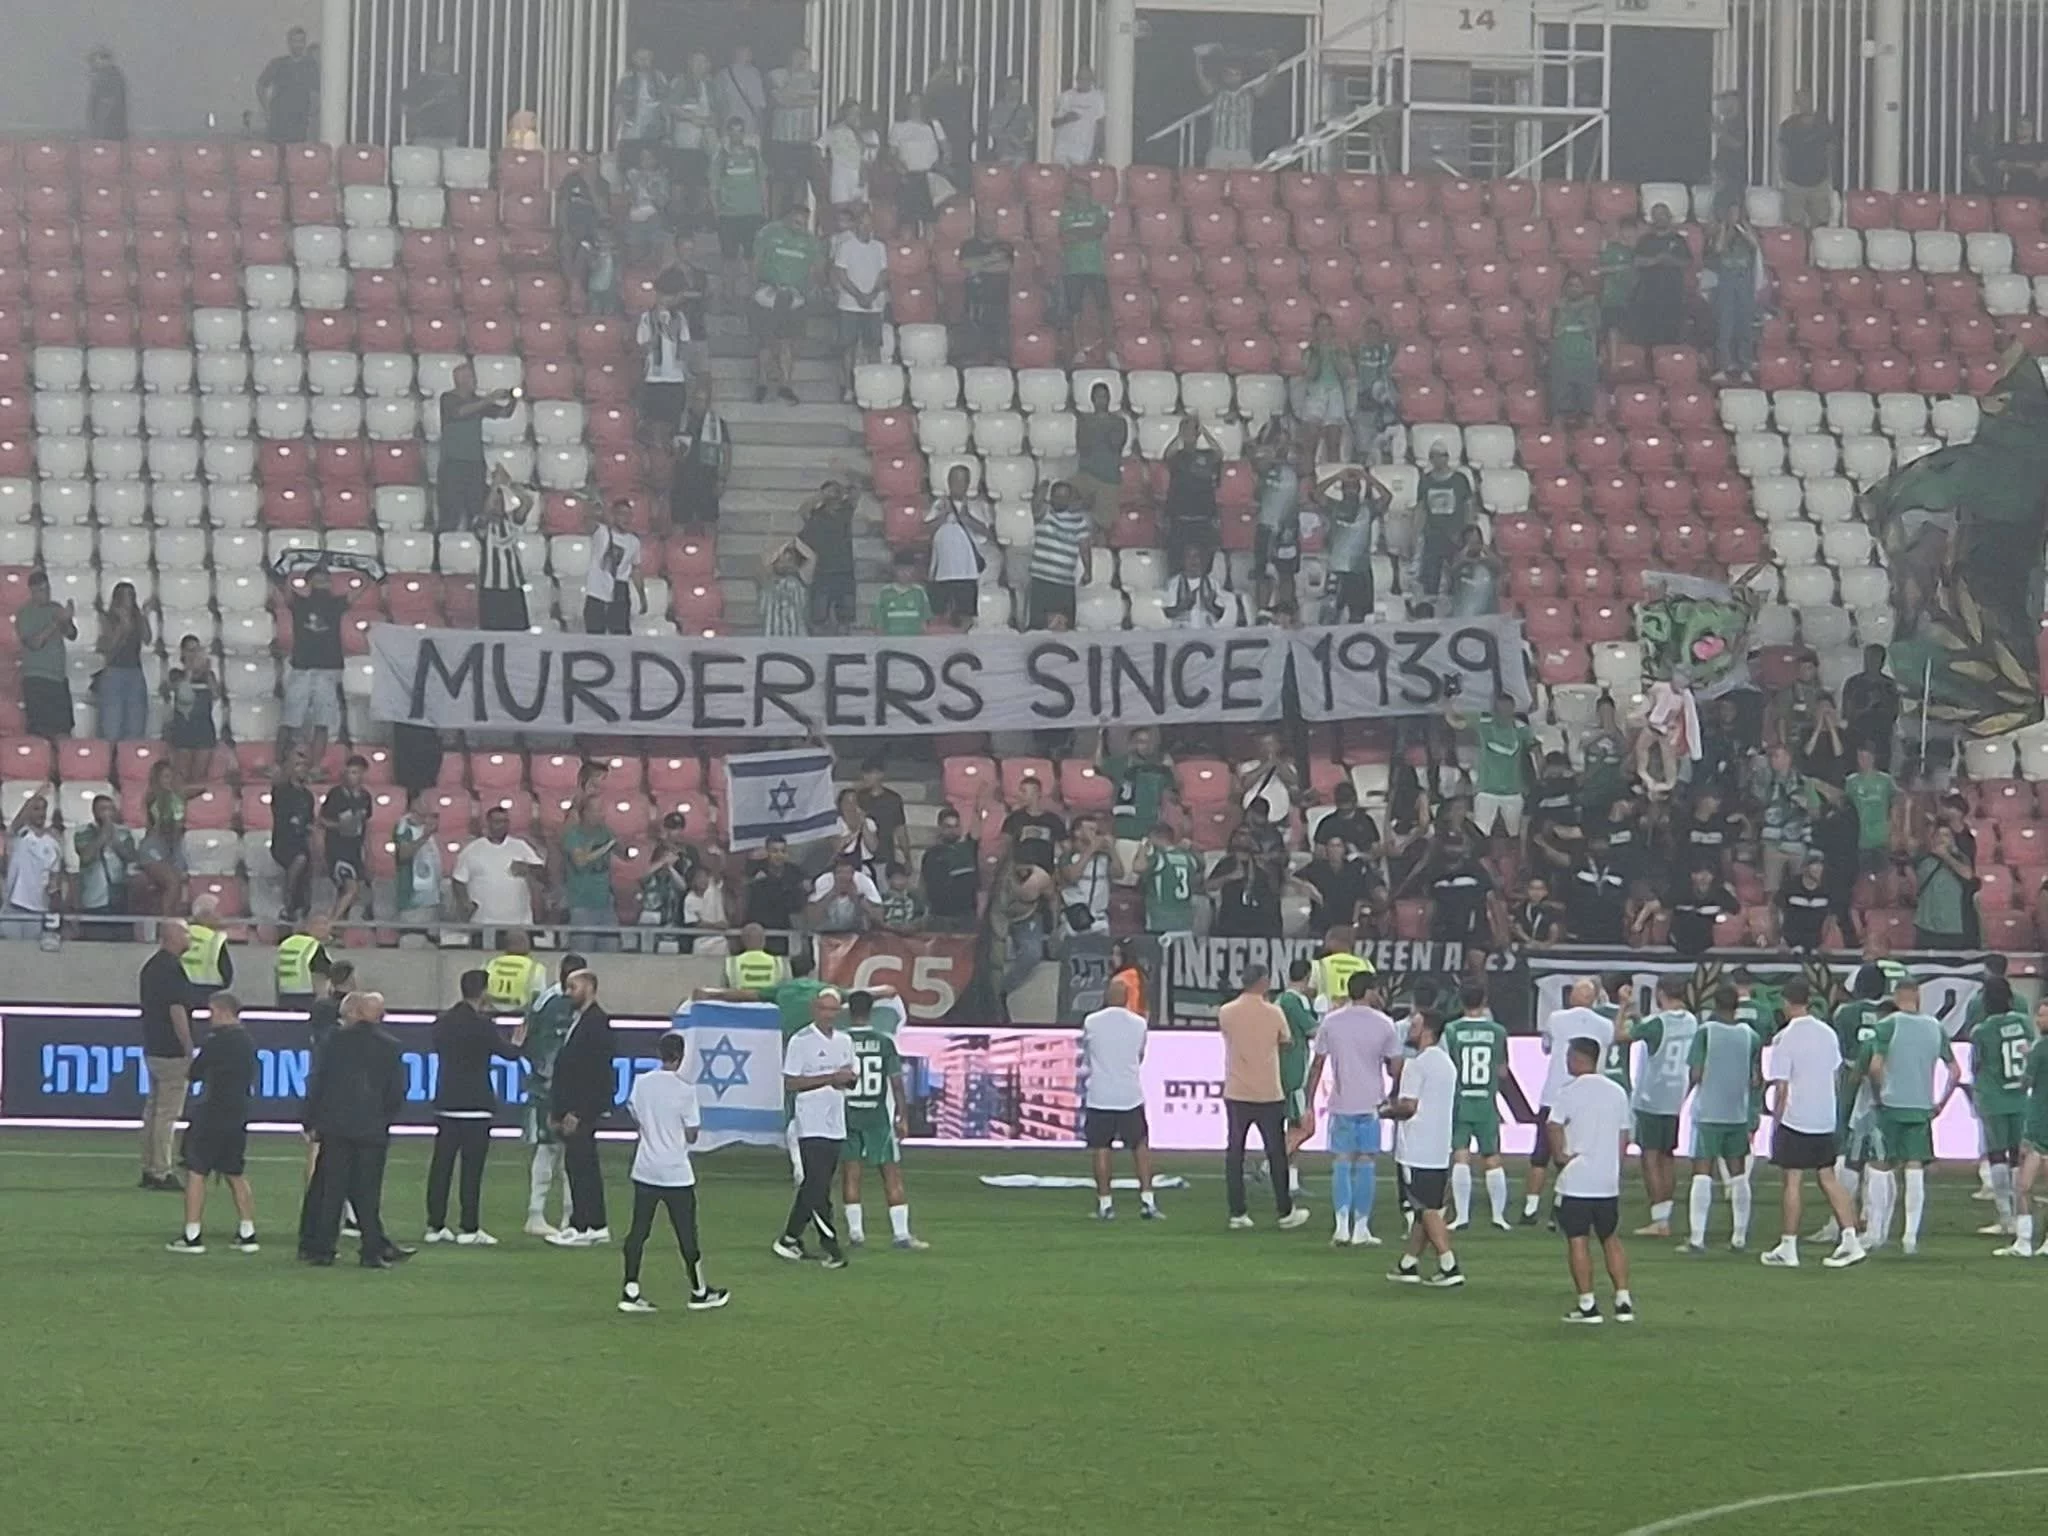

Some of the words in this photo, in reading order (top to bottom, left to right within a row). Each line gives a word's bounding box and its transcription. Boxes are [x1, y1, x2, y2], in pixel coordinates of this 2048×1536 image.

[1457, 9, 1496, 31] 14
[410, 639, 984, 729] MURDERERS
[1028, 638, 1270, 718] SINCE
[1314, 627, 1502, 709] 1939
[1461, 1045, 1491, 1085] 18
[2001, 1038, 2028, 1079] 15
